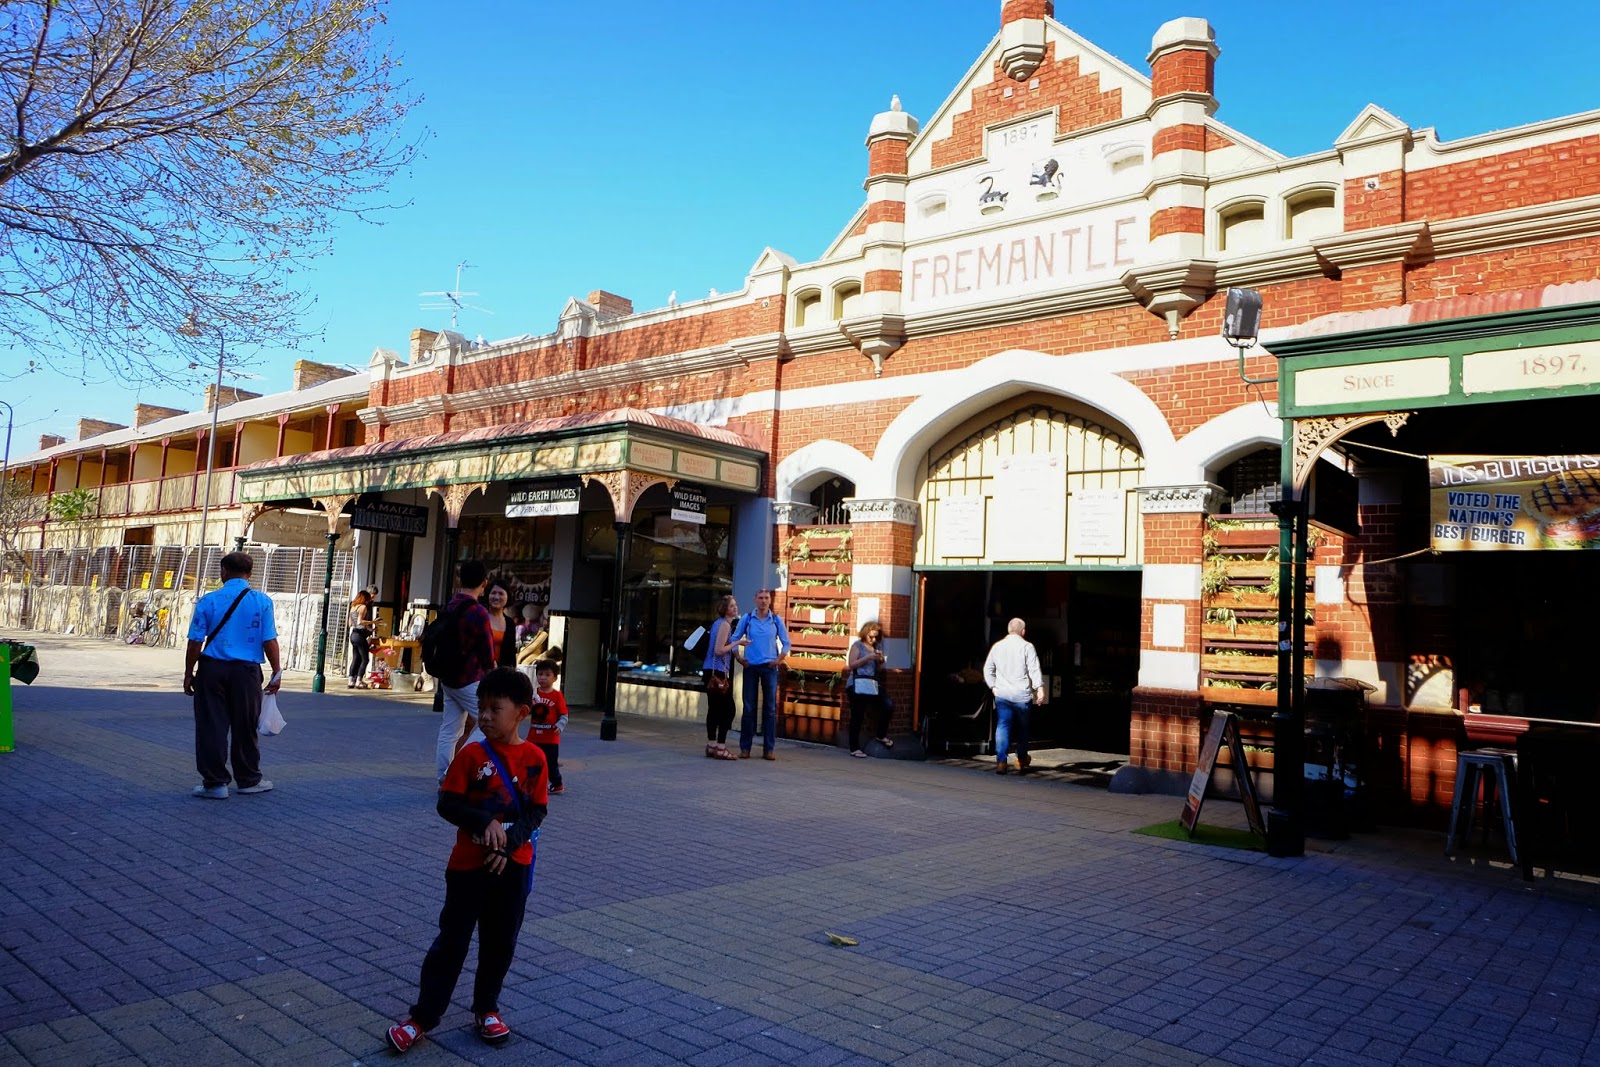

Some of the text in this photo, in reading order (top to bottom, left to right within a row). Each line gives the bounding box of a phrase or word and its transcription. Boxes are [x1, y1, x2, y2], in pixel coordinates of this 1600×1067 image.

[1002, 124, 1039, 147] 1897
[911, 216, 1137, 302] FREMANTLE
[511, 488, 577, 503] WILD EARTH IMAGES
[674, 491, 707, 503] WILD EARTH
[1448, 491, 1521, 510] VOTED THE
[367, 502, 417, 516] A MAIZE
[680, 501, 700, 511] IMAGES
[1448, 509, 1515, 527] NATION'S
[484, 527, 526, 552] 1897
[1434, 524, 1526, 545] BEST BURGER
